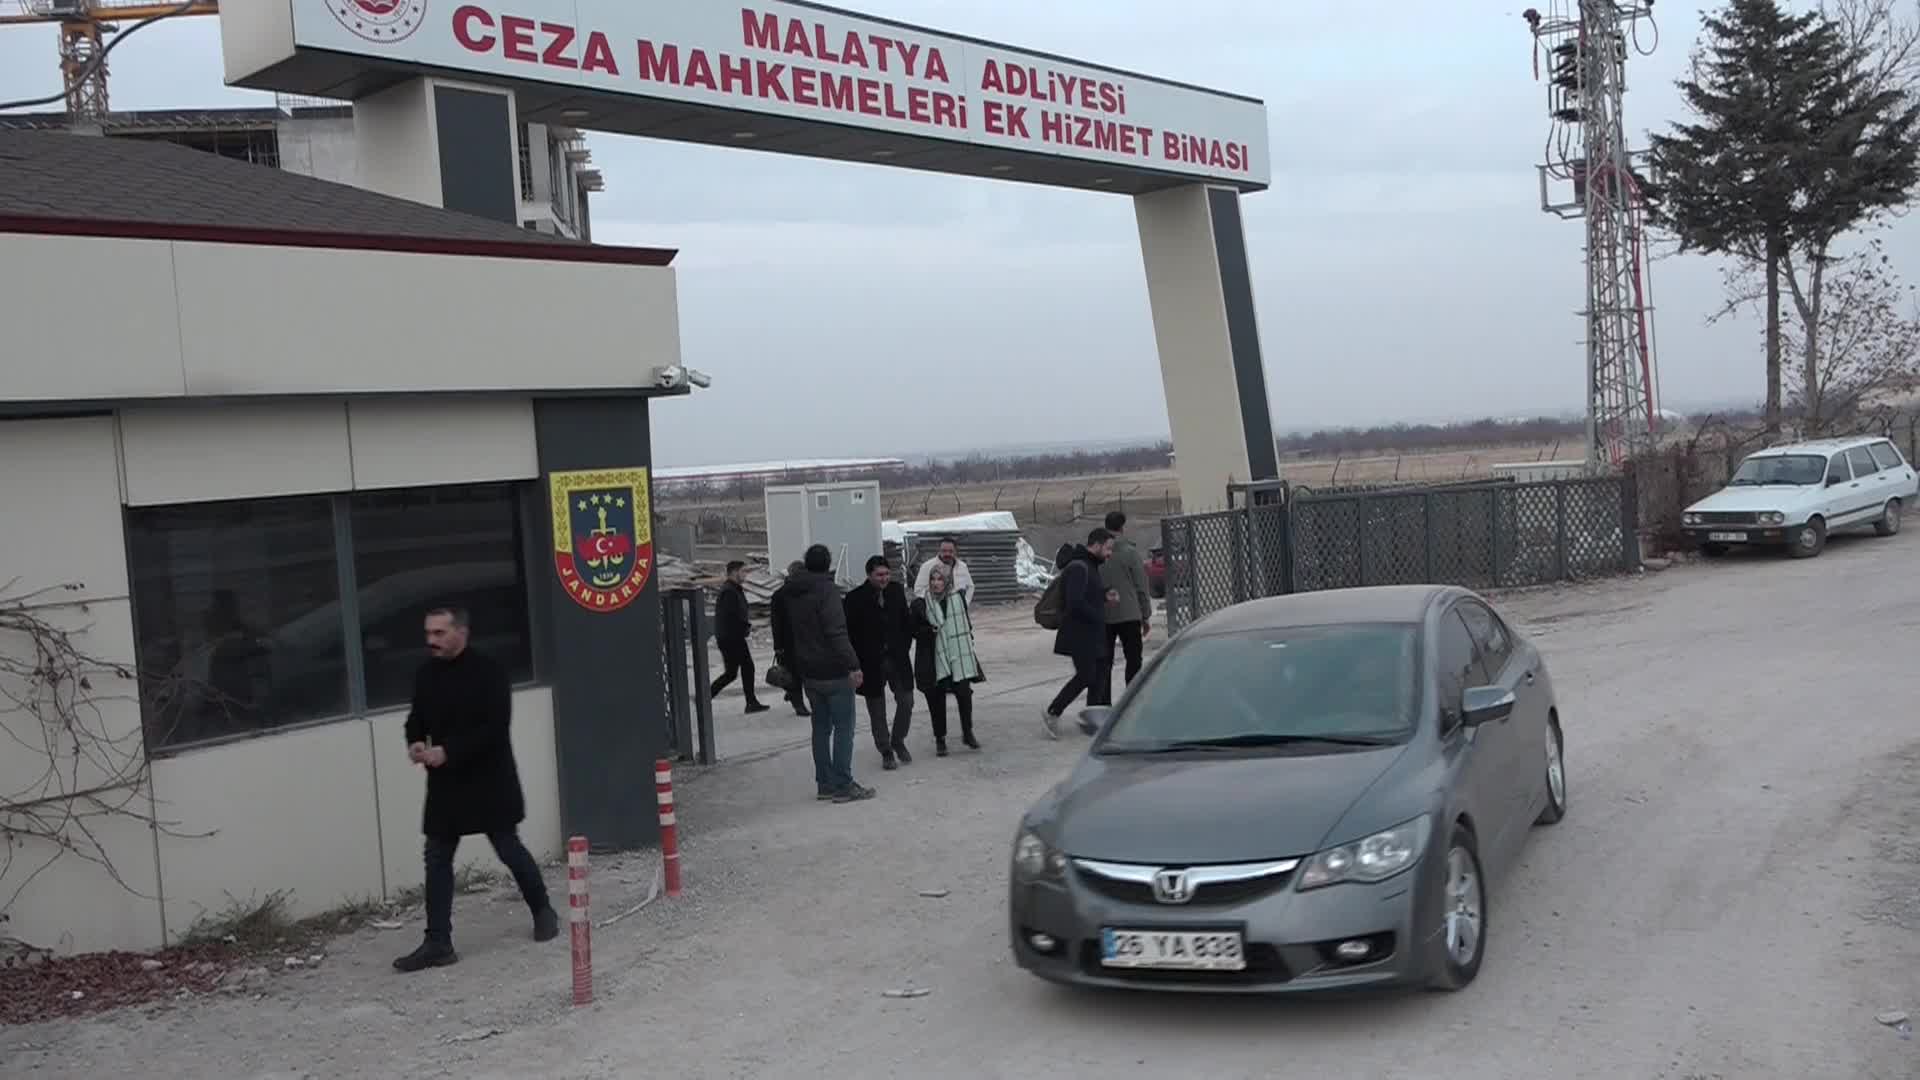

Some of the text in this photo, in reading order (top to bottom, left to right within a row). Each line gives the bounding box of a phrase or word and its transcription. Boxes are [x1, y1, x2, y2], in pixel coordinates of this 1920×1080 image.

[452, 6, 620, 77] CEZA
[983, 100, 1031, 139] EK
[742, 8, 949, 84] MALATYA
[562, 558, 648, 605] JANDARMA
[1114, 934, 1241, 958] 26 YA 838
